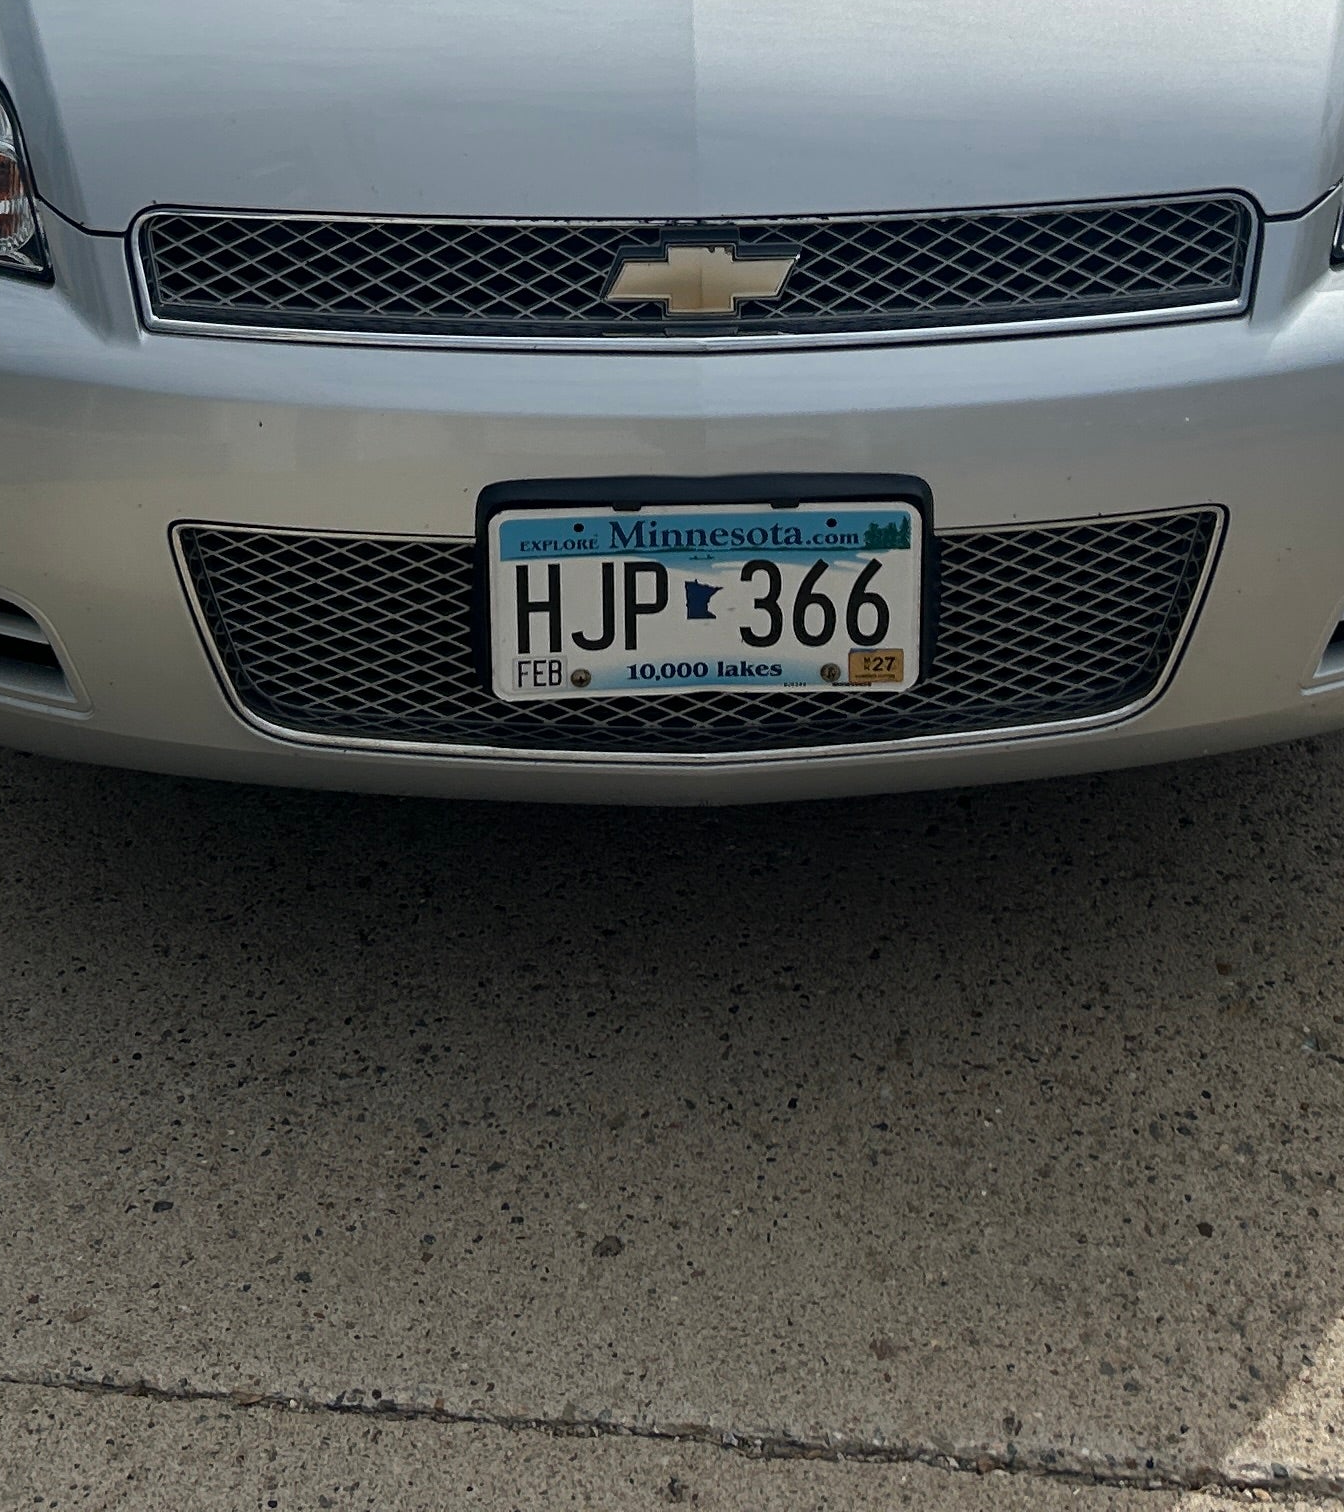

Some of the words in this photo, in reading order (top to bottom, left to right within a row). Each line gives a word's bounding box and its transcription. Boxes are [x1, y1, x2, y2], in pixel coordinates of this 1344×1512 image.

[519, 536, 600, 553] EXPLORE
[609, 518, 860, 550] Minnesota.com
[515, 560, 670, 654] HJP
[739, 557, 891, 648] 366
[517, 659, 563, 688] FEB
[627, 662, 709, 682] 10,000
[717, 660, 783, 679] lakes
[872, 656, 896, 672] 27
